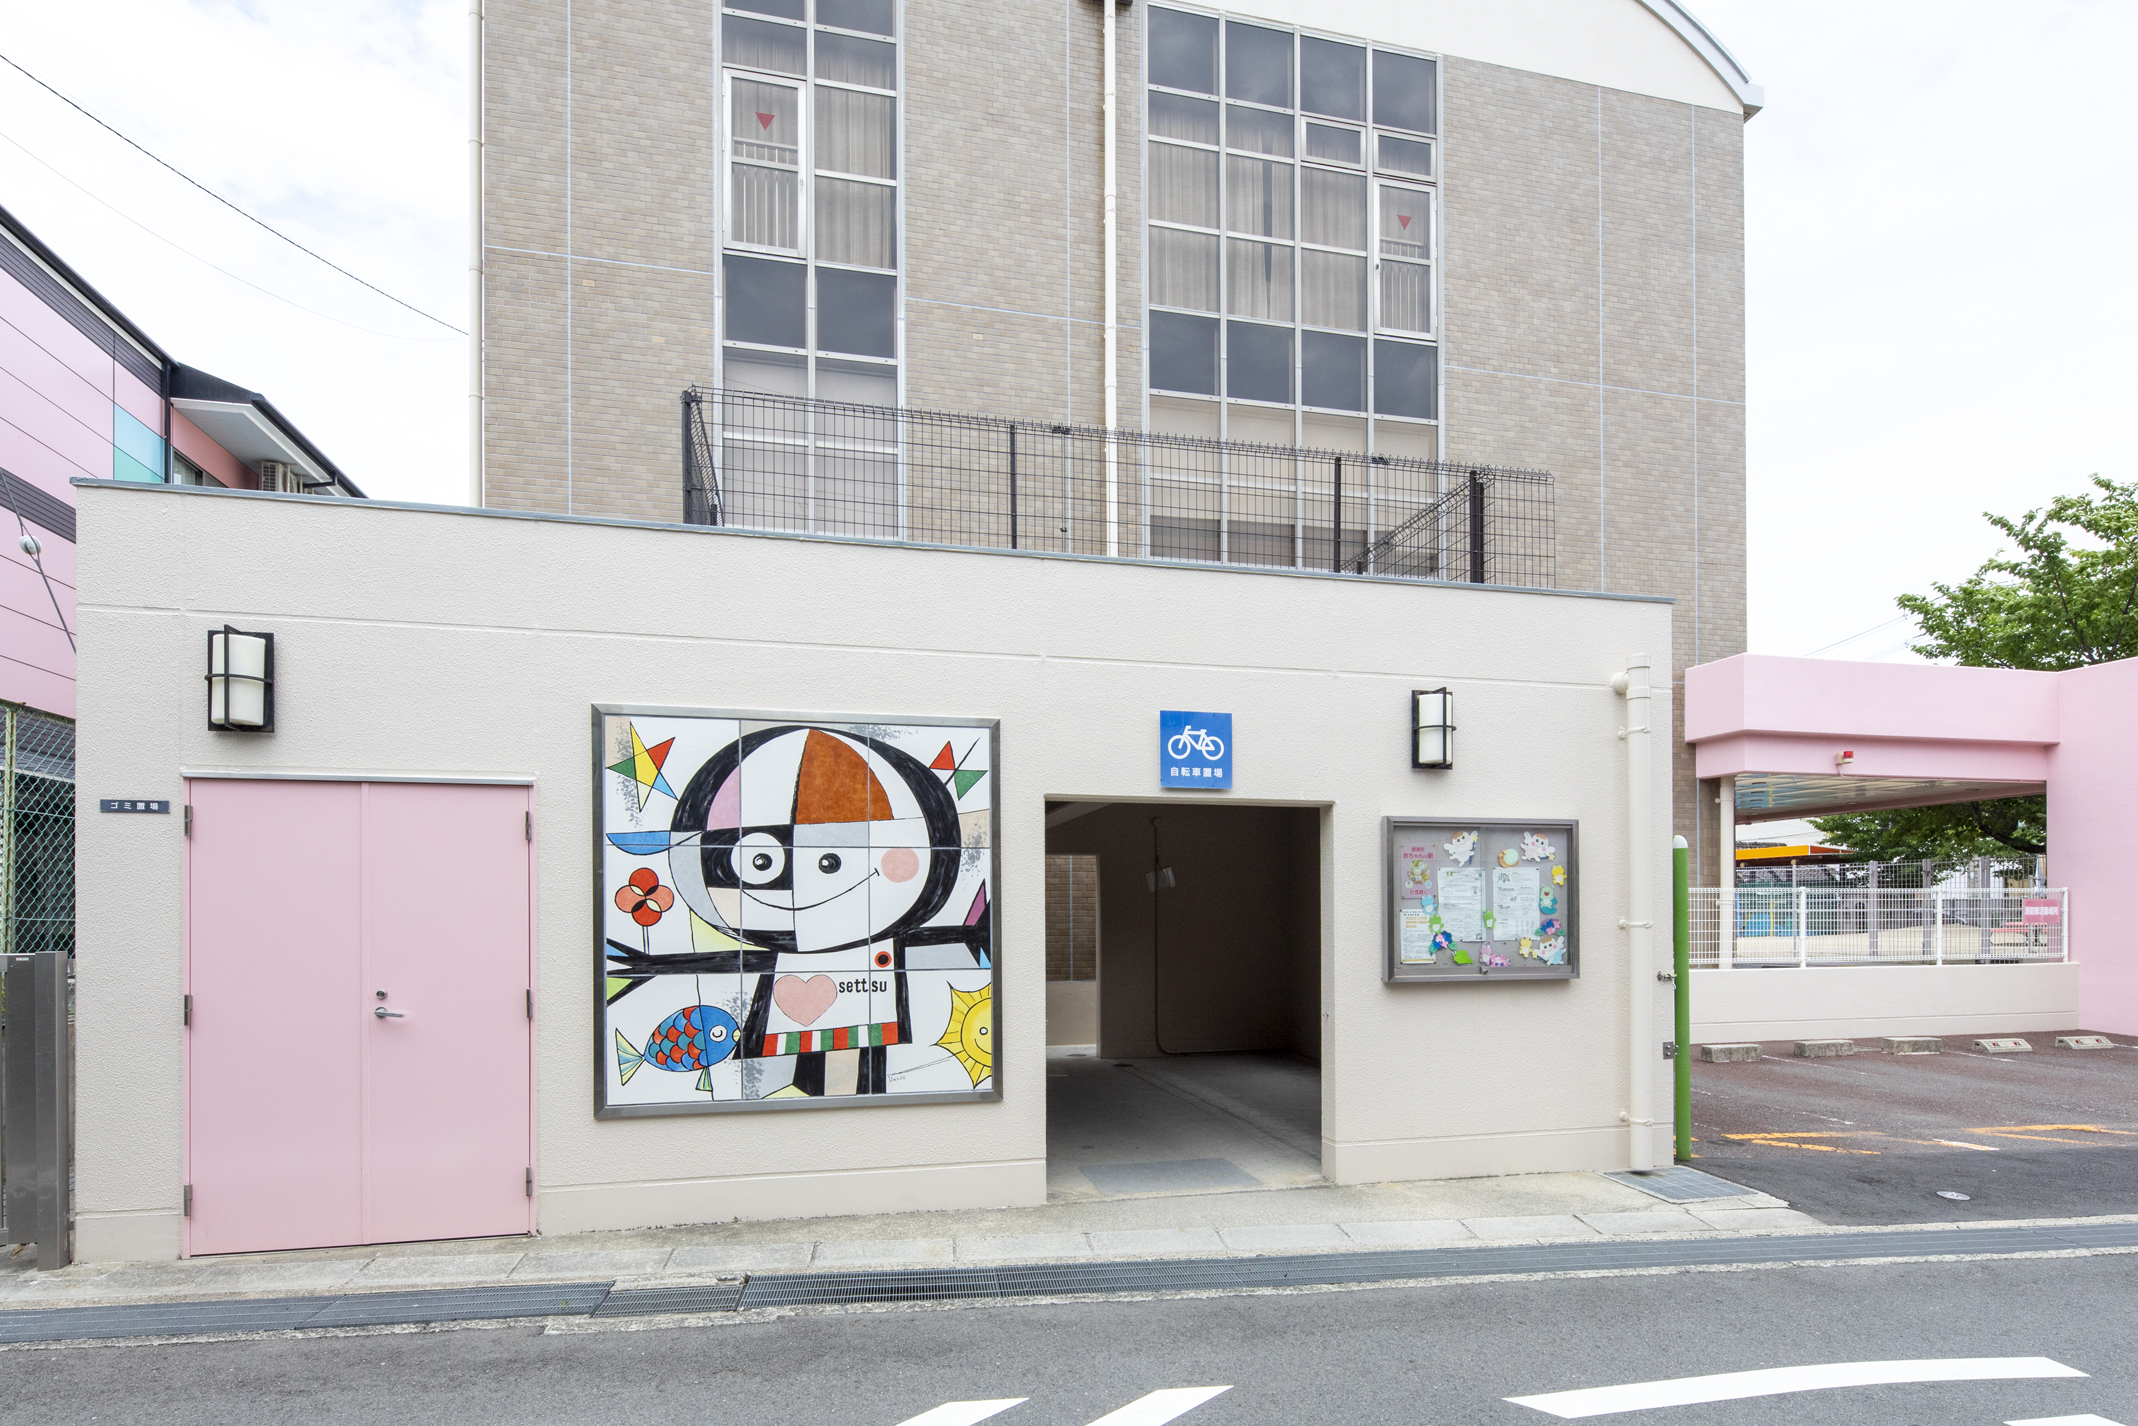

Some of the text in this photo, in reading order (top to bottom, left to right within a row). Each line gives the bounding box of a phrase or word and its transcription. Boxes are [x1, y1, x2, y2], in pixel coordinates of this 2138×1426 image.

[1170, 767, 1223, 778] 自転車置場
[110, 801, 159, 811] ゴミ置場
[838, 978, 887, 993] settsu
